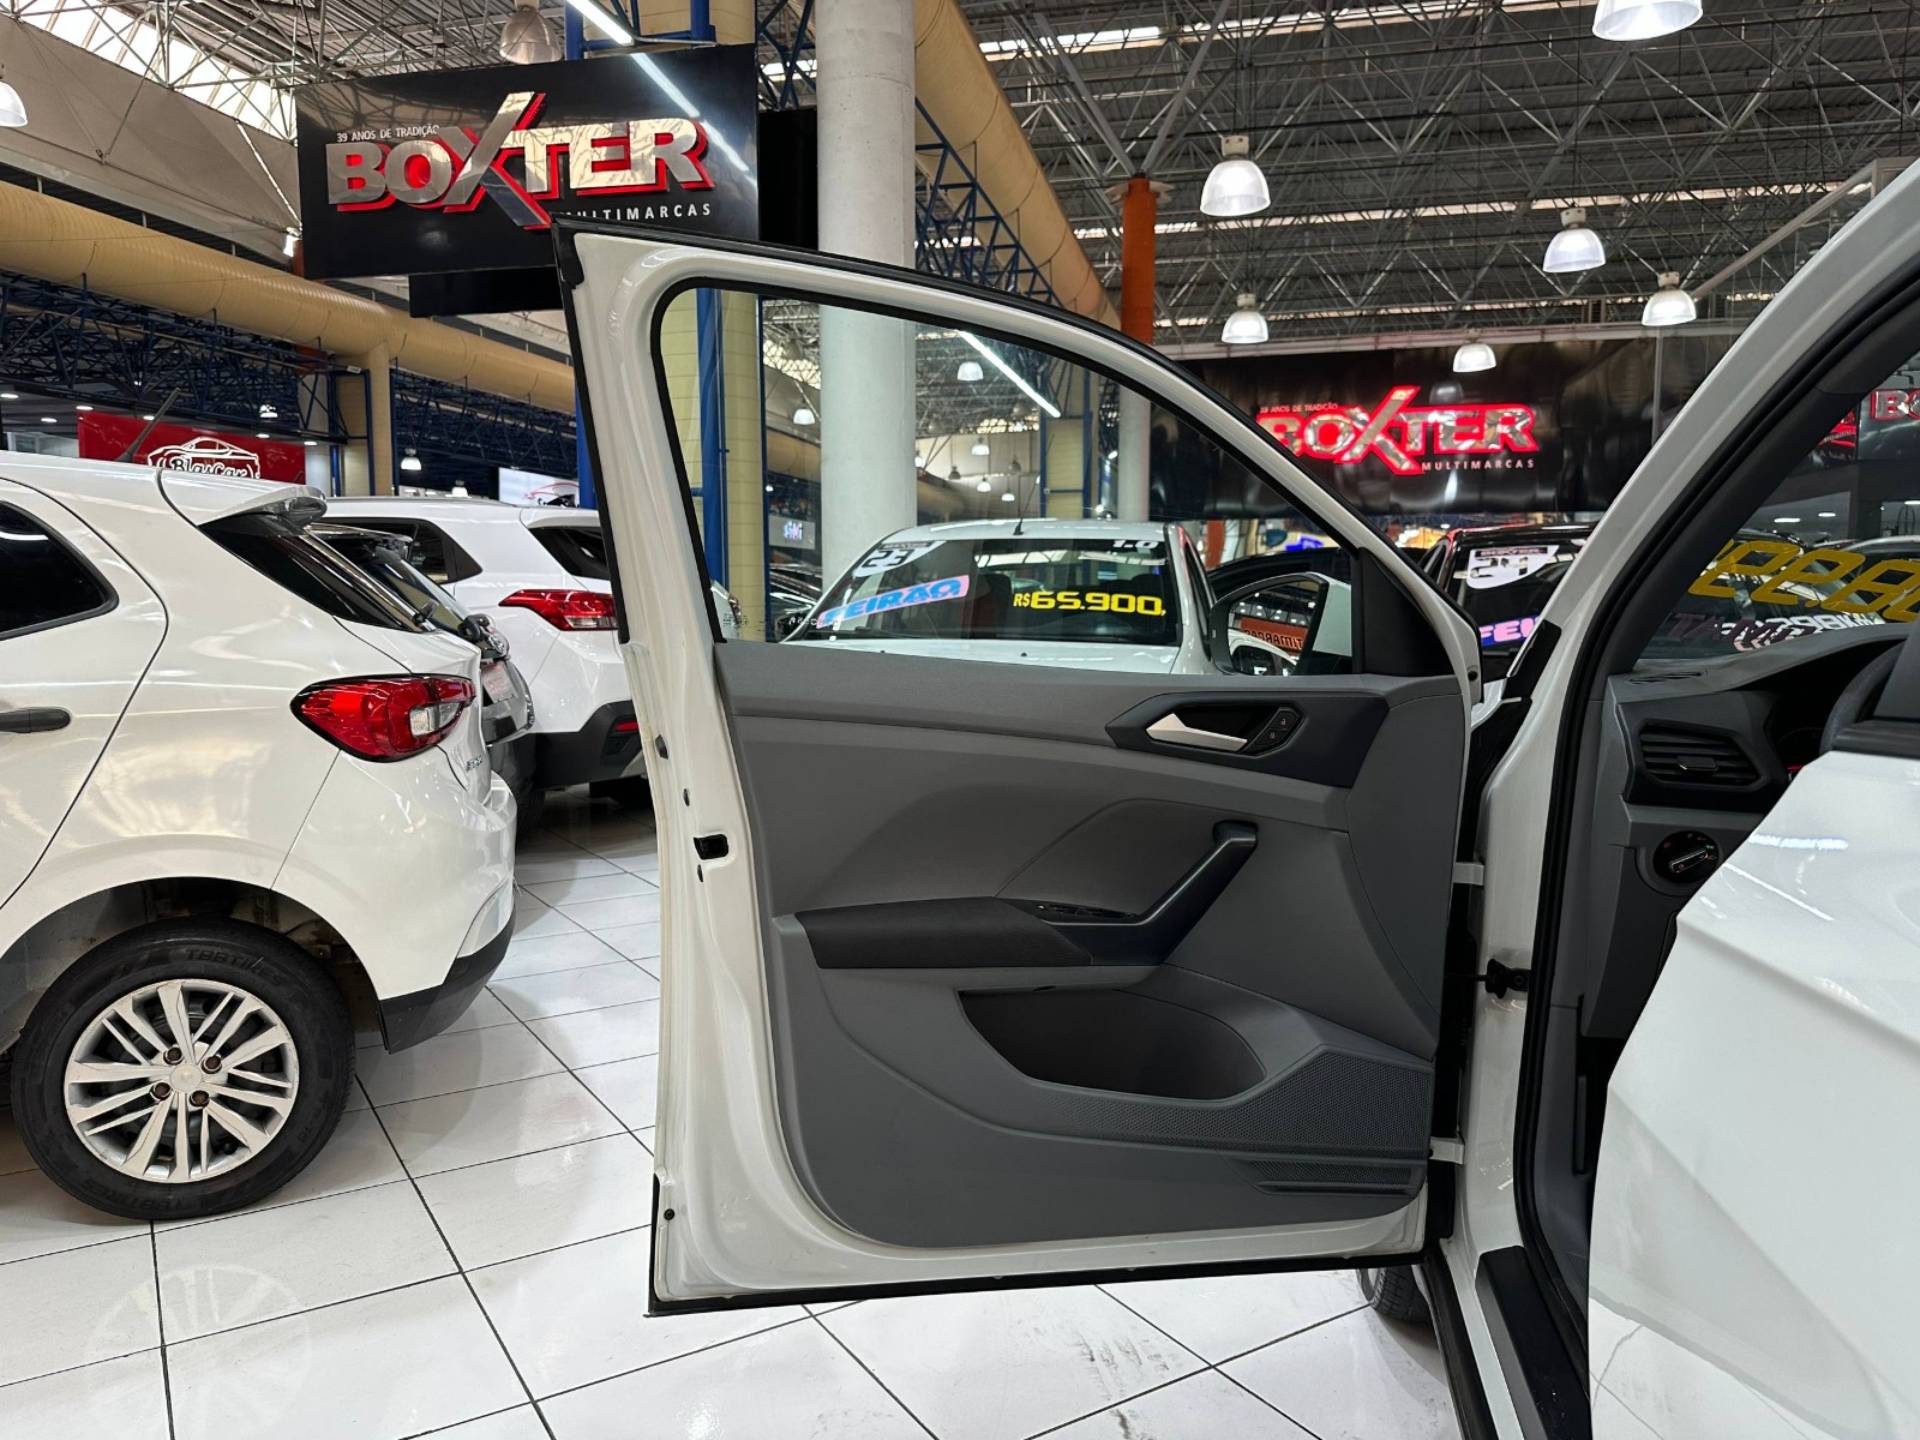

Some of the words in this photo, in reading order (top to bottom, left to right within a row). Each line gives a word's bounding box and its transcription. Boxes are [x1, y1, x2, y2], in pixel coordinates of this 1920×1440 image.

[336, 133, 348, 143] 39
[351, 131, 376, 141] ANOS
[379, 128, 392, 139] DE
[396, 123, 440, 138] TRADIÇÃO
[326, 91, 716, 229] BOXTER
[559, 203, 711, 221] TIMARCAS
[1256, 385, 1541, 475] BOXTER
[1421, 459, 1535, 471] MULTIMARCAS
